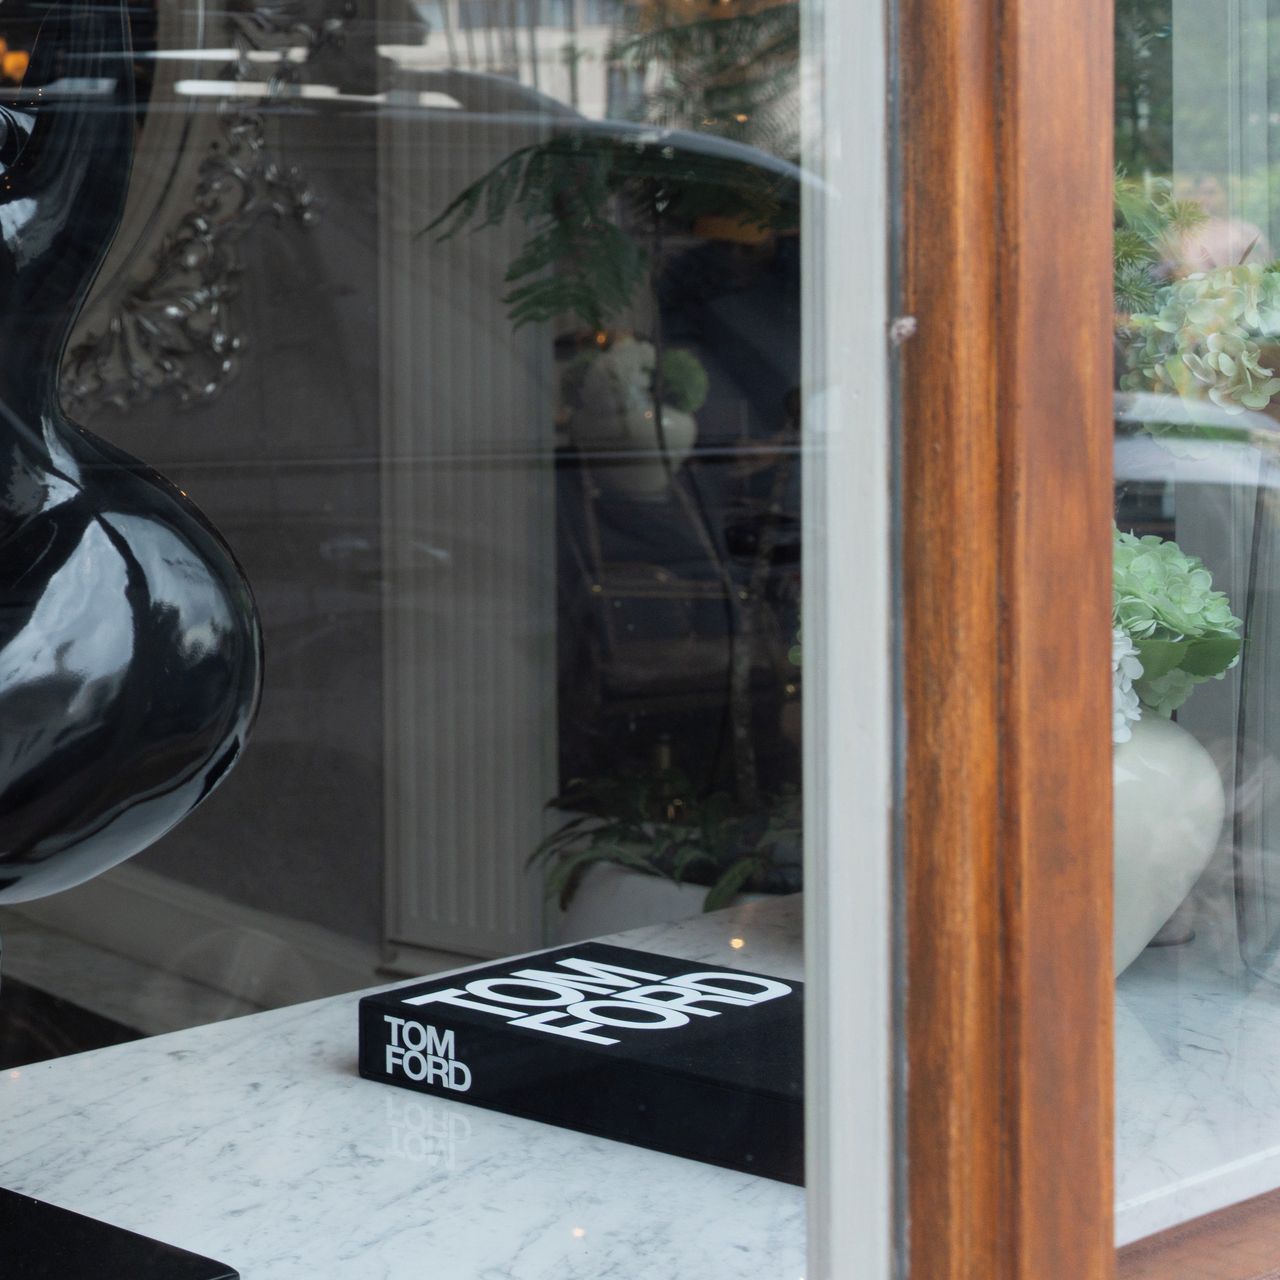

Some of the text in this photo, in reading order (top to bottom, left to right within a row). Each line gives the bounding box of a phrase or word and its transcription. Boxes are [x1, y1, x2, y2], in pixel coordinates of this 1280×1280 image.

[400, 957, 669, 1019] TOM
[506, 971, 793, 1046] FORD
[383, 1014, 455, 1061] TOM
[385, 1043, 472, 1093] FORD
